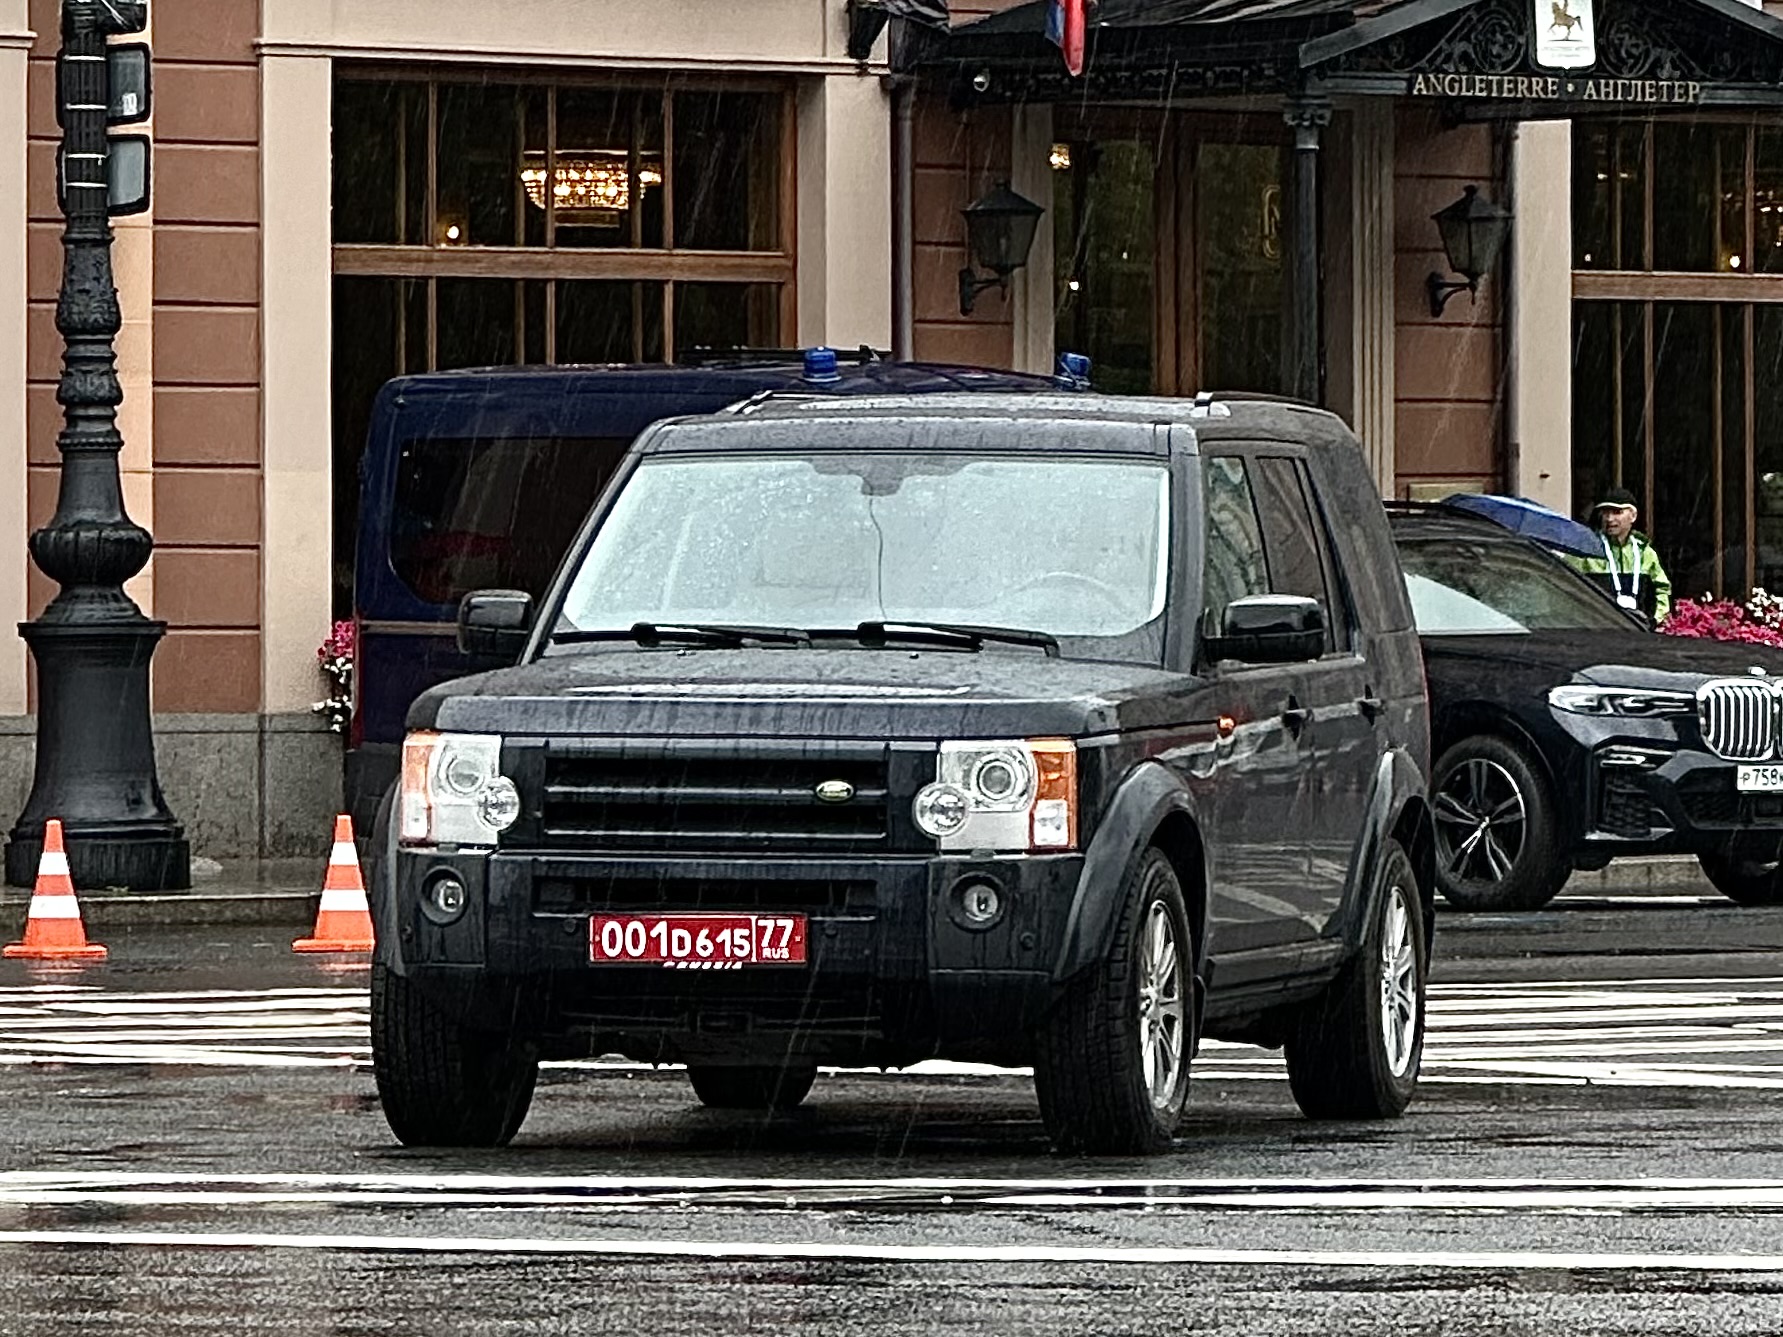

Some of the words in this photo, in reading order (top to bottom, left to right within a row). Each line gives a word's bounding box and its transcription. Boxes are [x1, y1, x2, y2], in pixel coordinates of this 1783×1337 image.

[1412, 74, 1559, 98] ANGLETERRE
[1583, 80, 1701, 103] АНГЛЕТЕР
[757, 919, 794, 948] 77
[762, 947, 790, 959] RUS
